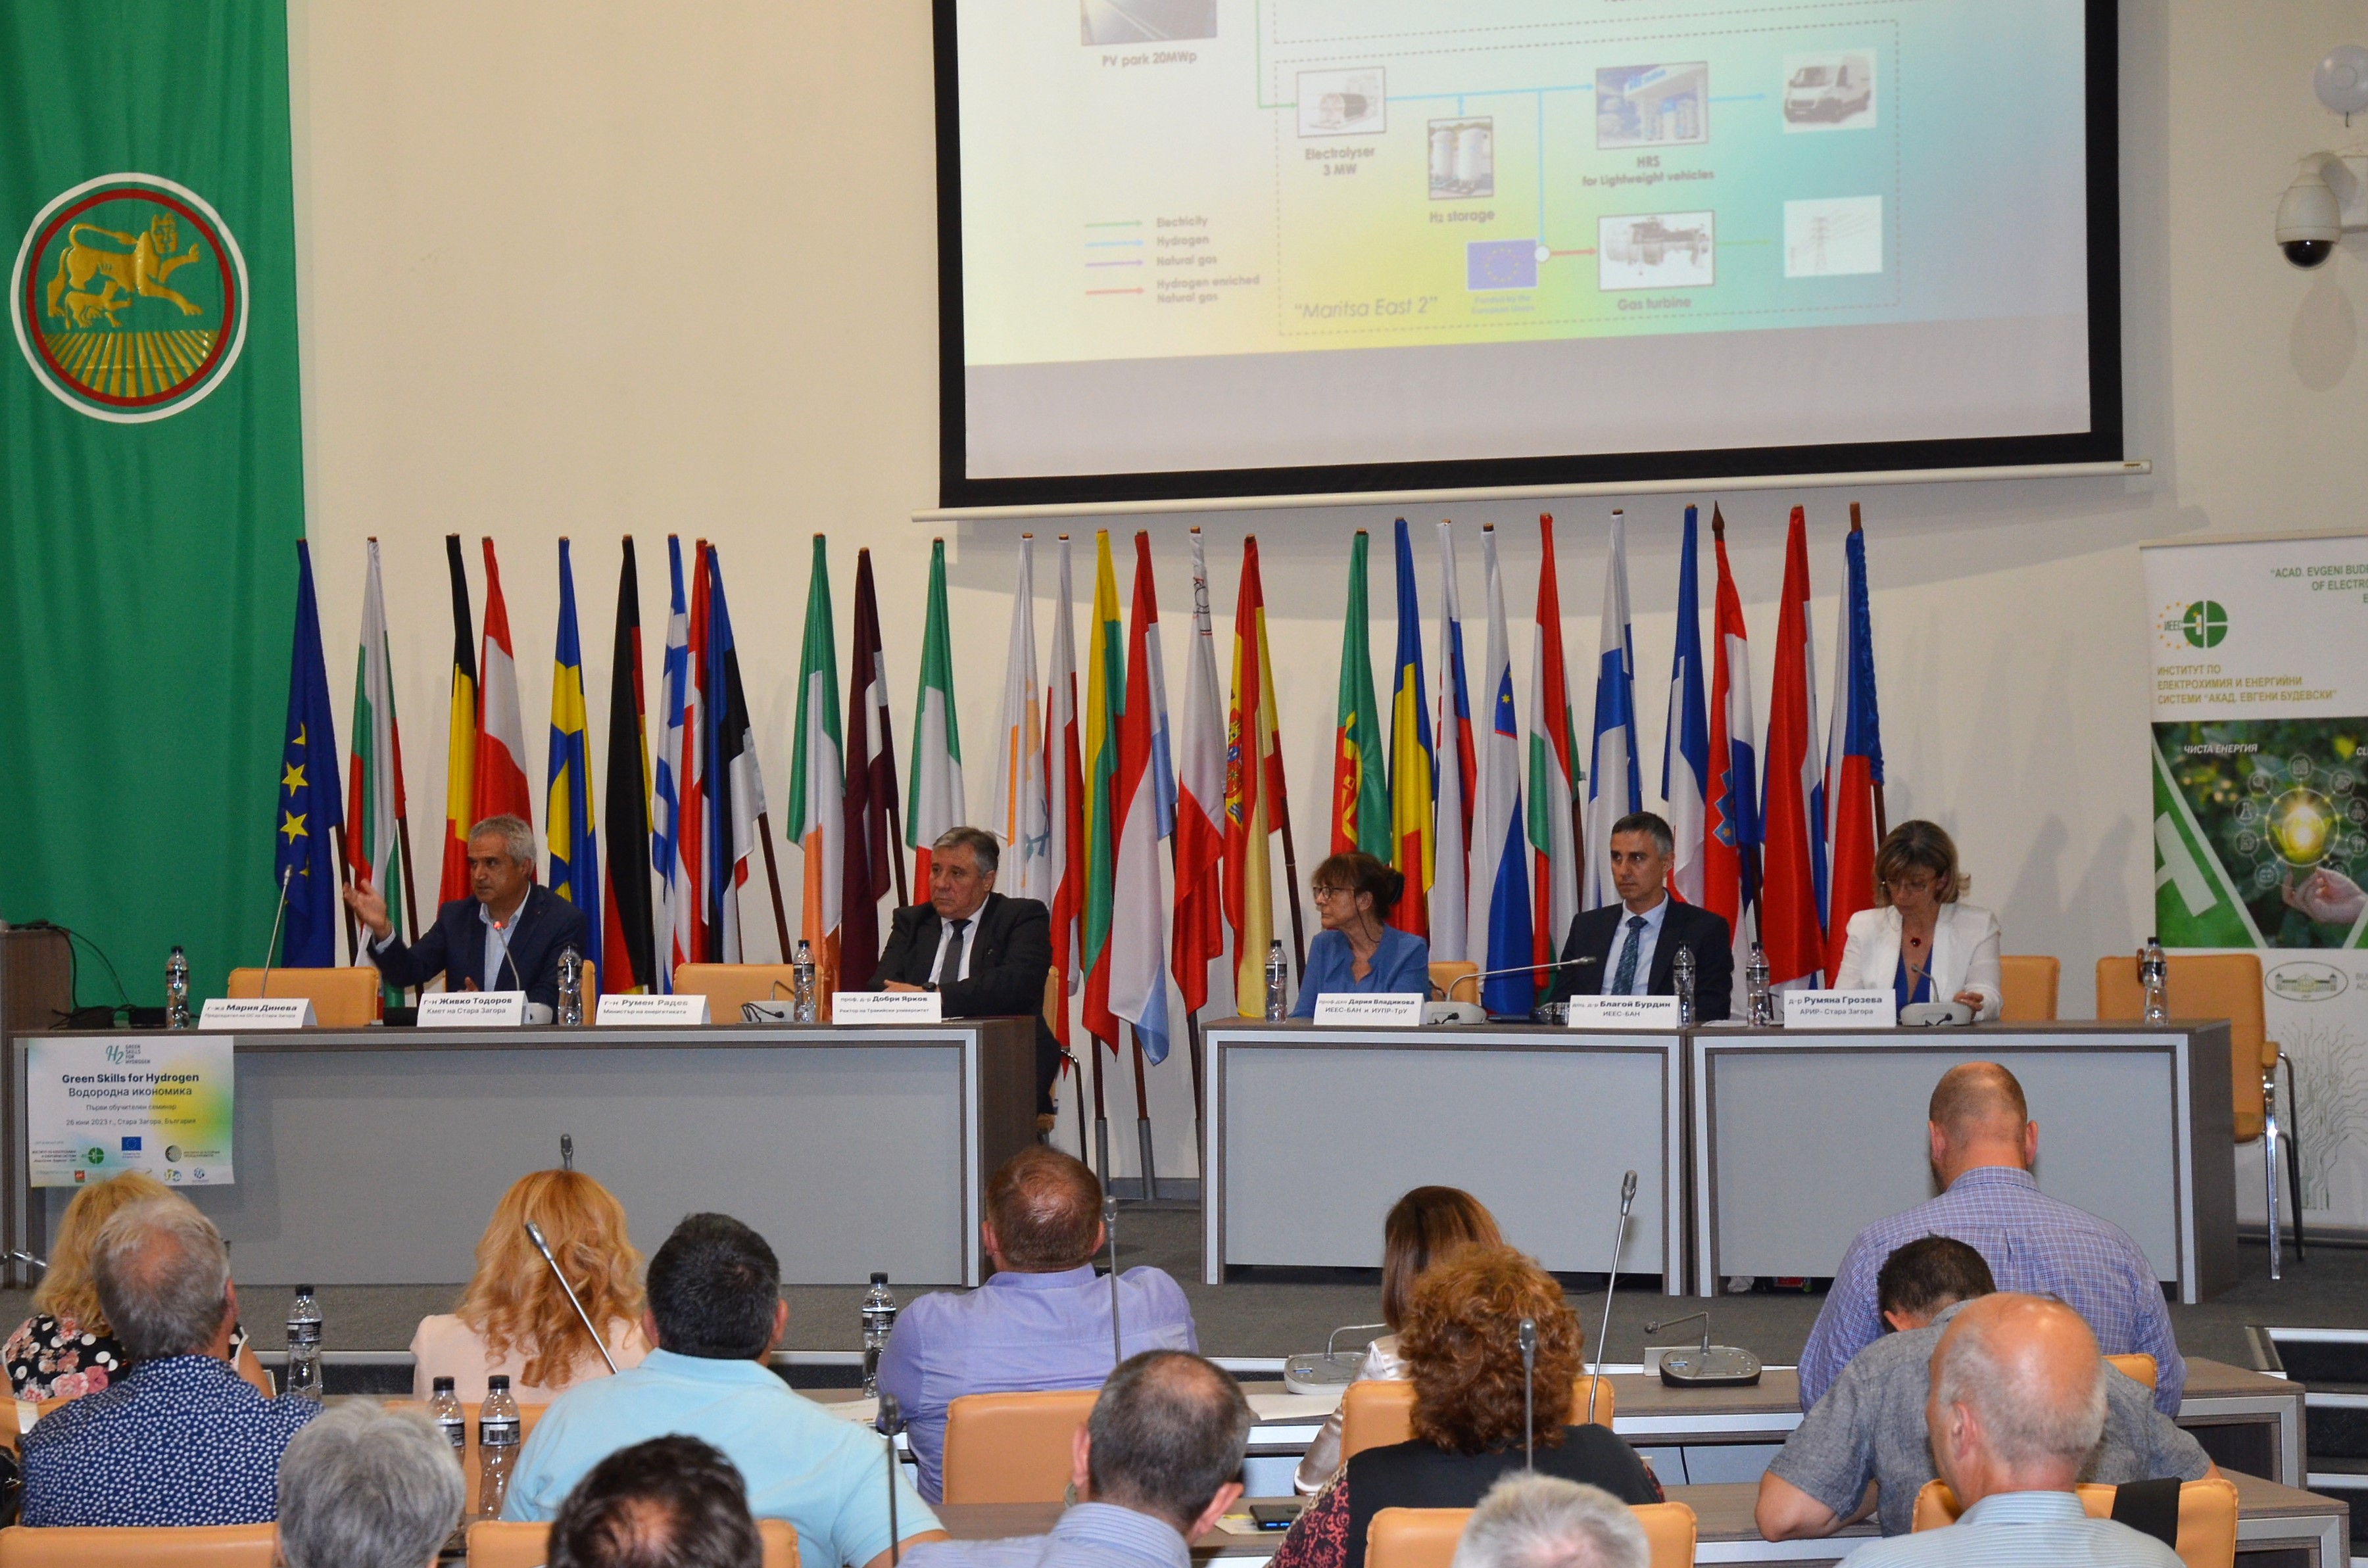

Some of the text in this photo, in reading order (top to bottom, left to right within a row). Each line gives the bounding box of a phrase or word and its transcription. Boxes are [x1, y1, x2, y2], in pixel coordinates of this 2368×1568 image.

[1102, 50, 1197, 68] PV park 20MWp
[1305, 146, 1375, 162] Electrolyser
[1637, 156, 1660, 168] HRS
[1323, 164, 1357, 176] 3 MW
[1582, 169, 1714, 189] for Lightweight vehicles
[1157, 216, 1208, 227] Electricity
[1447, 209, 1495, 224] storage
[1157, 235, 1209, 247] Hydrogen
[1157, 255, 1217, 267] Natural gas
[1157, 275, 1260, 291] Hydrogen enriched
[1157, 293, 1218, 304] Natural gas
[1618, 295, 1691, 311] Gas turbine
[1374, 300, 1413, 318] East
[2307, 565, 2343, 577] EVGENI
[2311, 581, 2325, 590] OF
[2157, 664, 2221, 676] ИНСТИТУТ ПО
[2158, 674, 2302, 690] ЕЛЕКТРОХИМИЯ И ЕНЕРГИЙНИ
[2158, 694, 2202, 705] СИСТЕМИ
[2240, 691, 2278, 702] ЕВГЕНИ
[2184, 744, 2258, 753] ЧИСТА ЕНЕРГИЯ
[62, 1073, 199, 1084] Green Skills for Hydrogen
[68, 1087, 192, 1098] Водородна икономика
